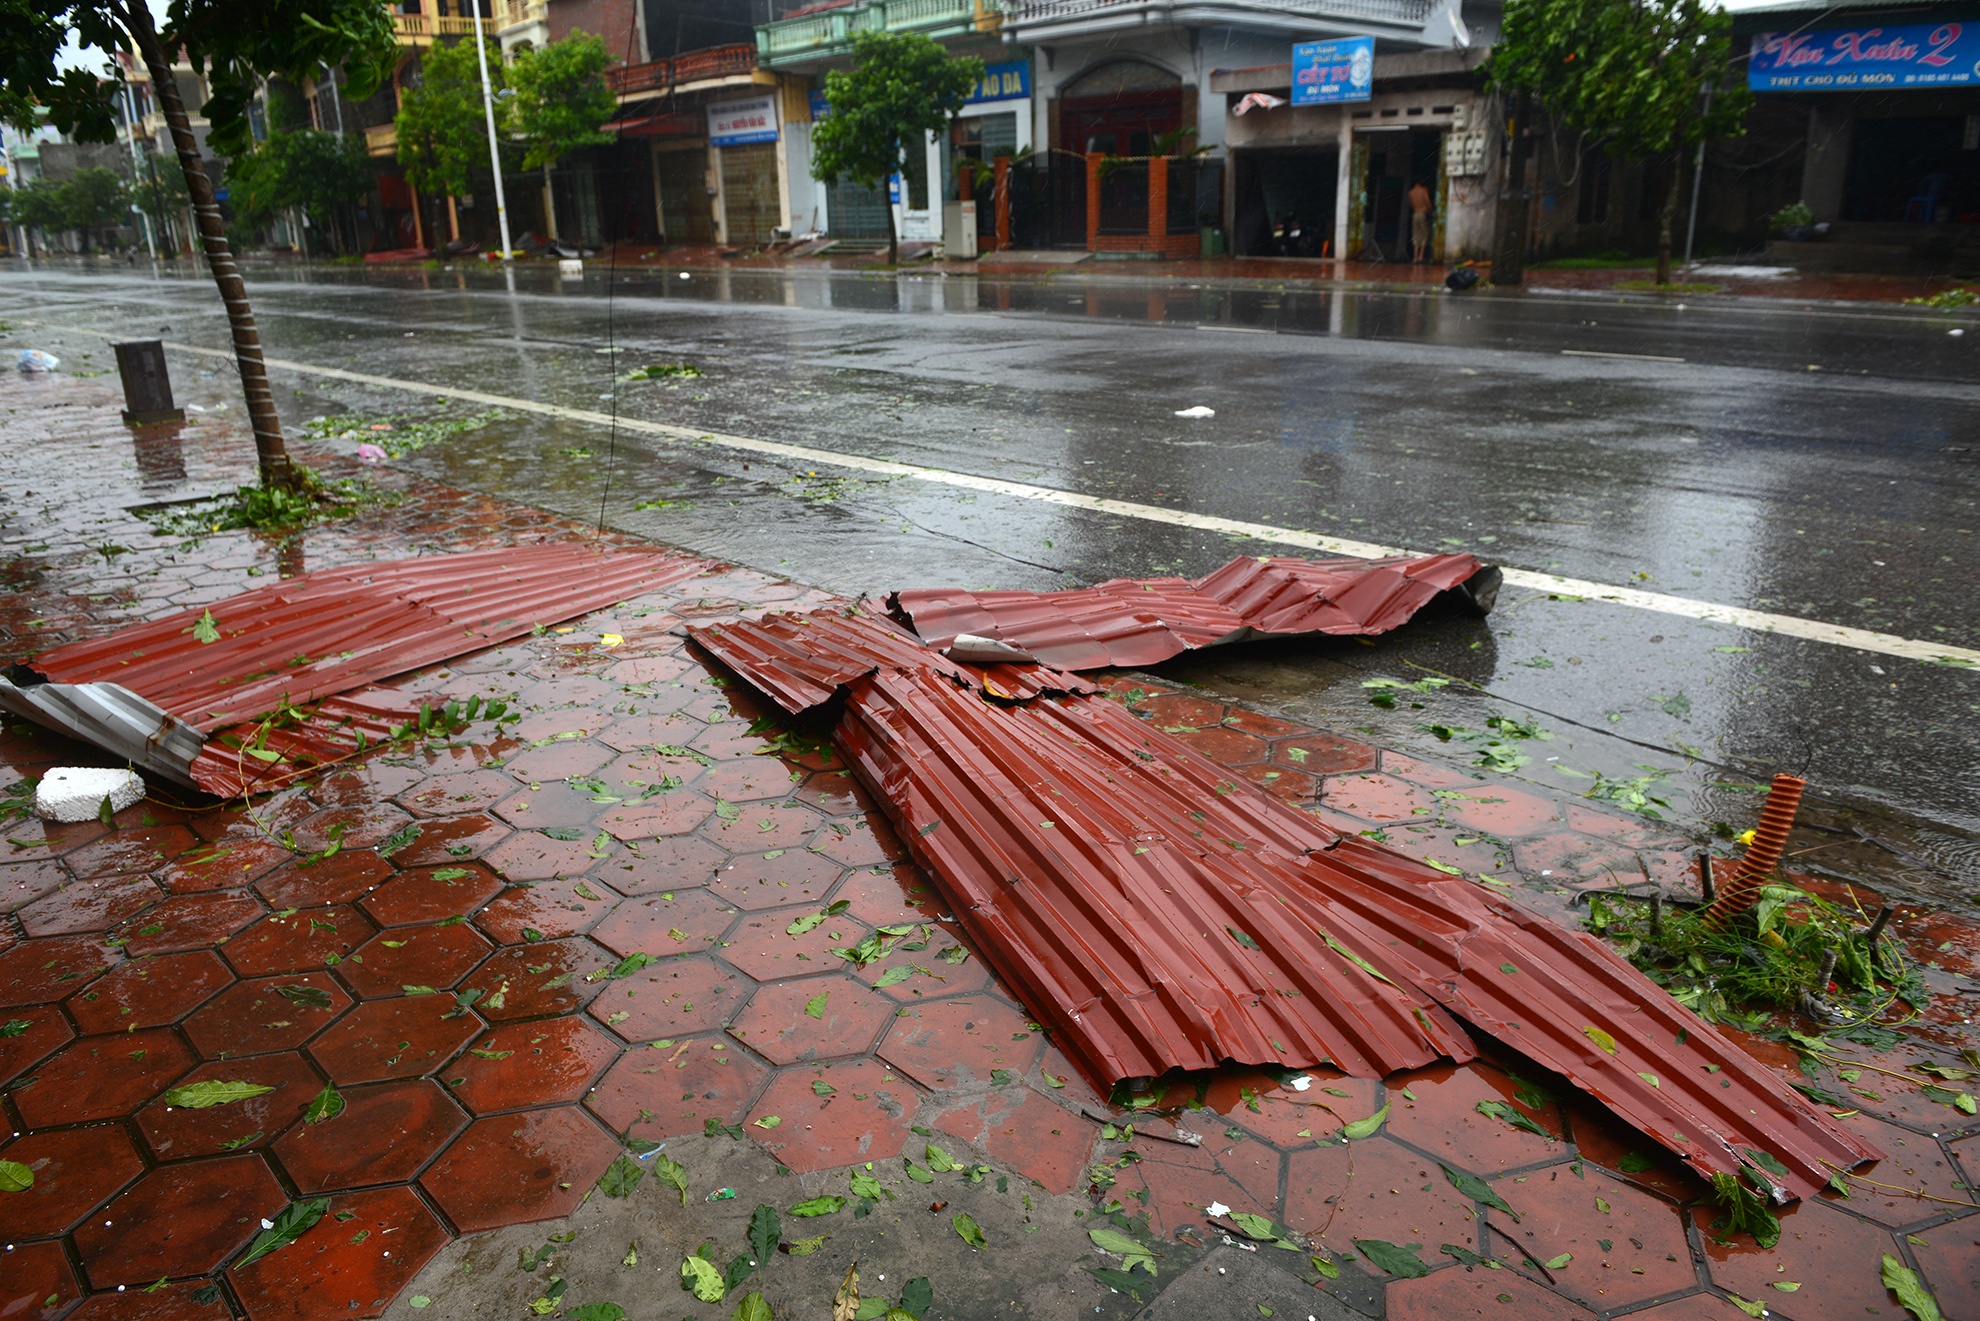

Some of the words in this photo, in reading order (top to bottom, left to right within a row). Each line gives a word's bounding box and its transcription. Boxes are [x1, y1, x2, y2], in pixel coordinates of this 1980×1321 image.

[1916, 22, 1963, 66] 2
[1002, 71, 1023, 95] DA
[1769, 75, 1802, 87] THỊT
[1803, 73, 1834, 86] CHÓ
[1861, 71, 1896, 84] MÓN
